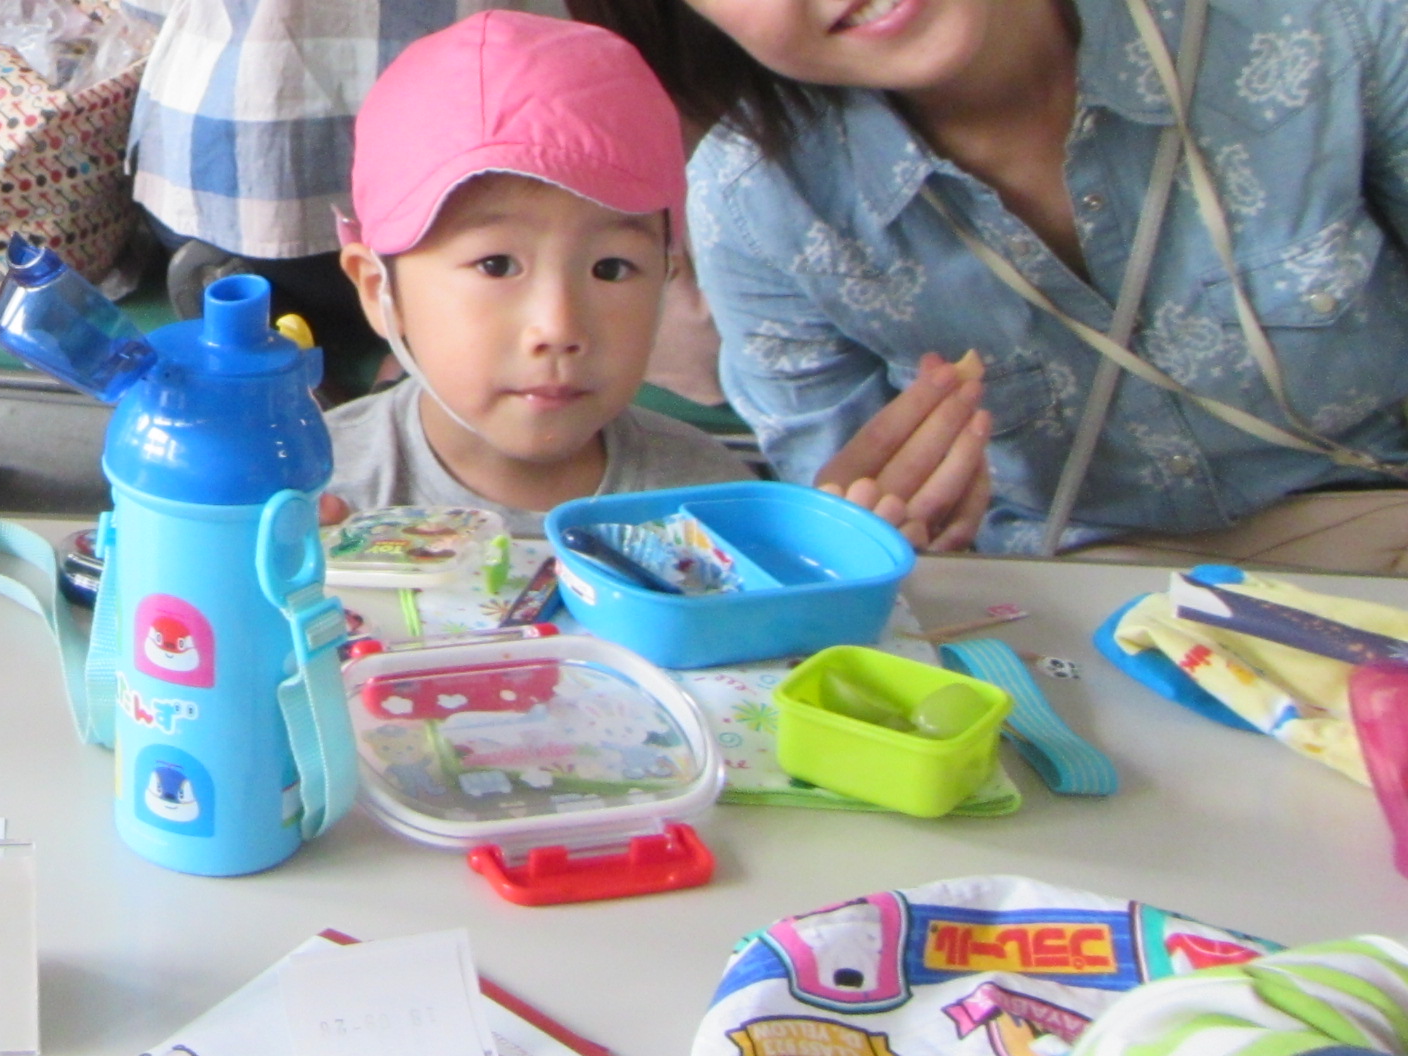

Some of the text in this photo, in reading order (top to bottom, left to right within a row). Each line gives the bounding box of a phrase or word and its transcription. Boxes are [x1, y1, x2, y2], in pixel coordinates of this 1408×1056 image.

[935, 924, 1111, 969] プラレール
[753, 1021, 830, 1043] YELLOW
